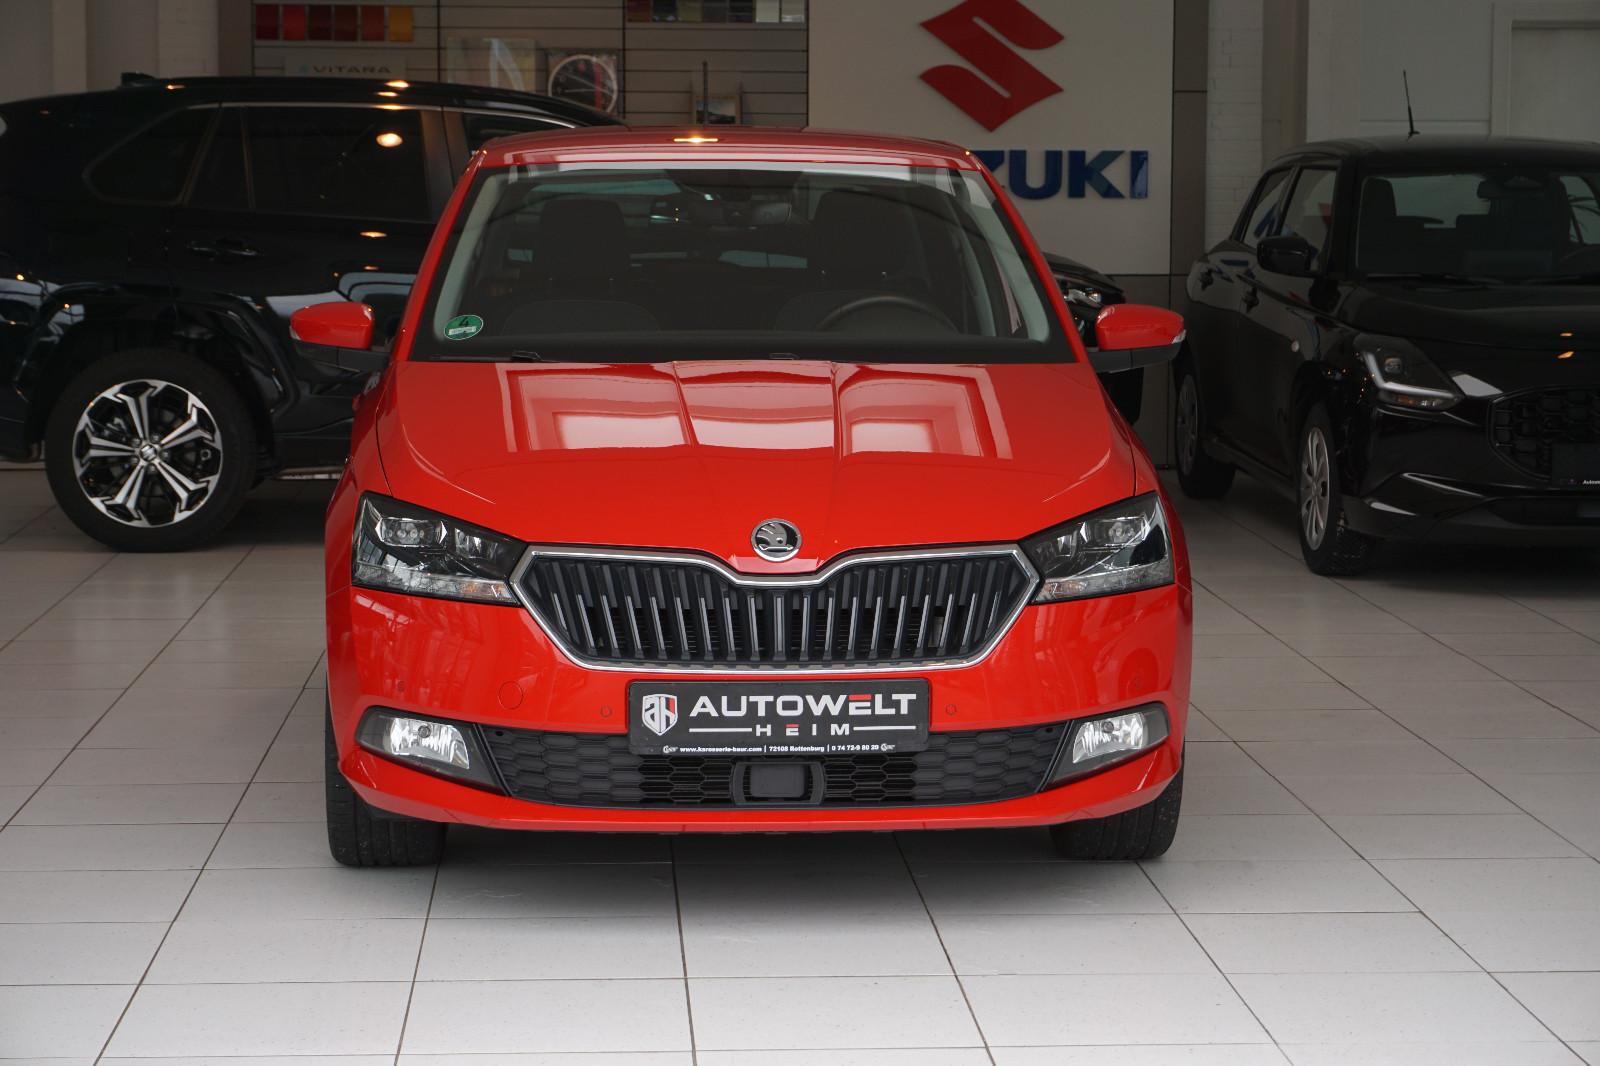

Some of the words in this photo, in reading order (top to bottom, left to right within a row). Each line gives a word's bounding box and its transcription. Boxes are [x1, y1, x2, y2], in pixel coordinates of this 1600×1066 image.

[313, 65, 391, 73] VITARA
[972, 150, 1149, 200] UKI
[689, 694, 917, 717] AUTOWELT
[756, 724, 850, 737] HEIM
[789, 745, 825, 754] Rottenburg
